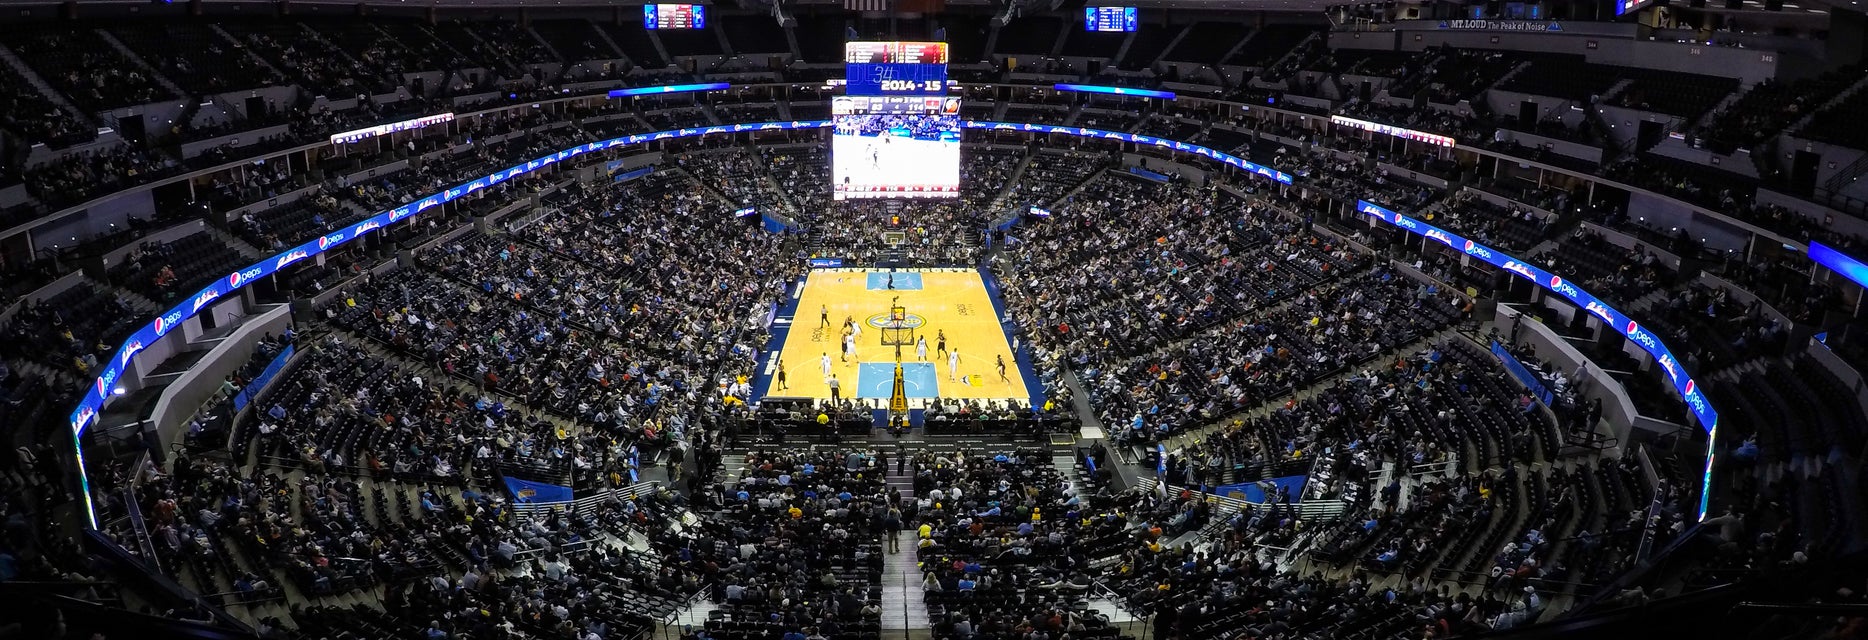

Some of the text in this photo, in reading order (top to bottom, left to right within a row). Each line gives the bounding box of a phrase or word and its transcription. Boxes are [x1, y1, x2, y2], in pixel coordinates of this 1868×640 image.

[1487, 21, 1500, 30] The
[1501, 21, 1517, 30] Peak
[1517, 22, 1525, 30] of
[1525, 22, 1546, 31] Noise
[881, 80, 916, 91] 2014
[924, 80, 941, 91] 15
[328, 233, 343, 246] pepsi
[1473, 247, 1491, 259] pepsi
[241, 267, 262, 283] pepsi
[1561, 283, 1577, 297] pepsi
[165, 310, 182, 330] pepsi
[1636, 331, 1656, 349] pepsi
[1690, 392, 1705, 415] pepsi
